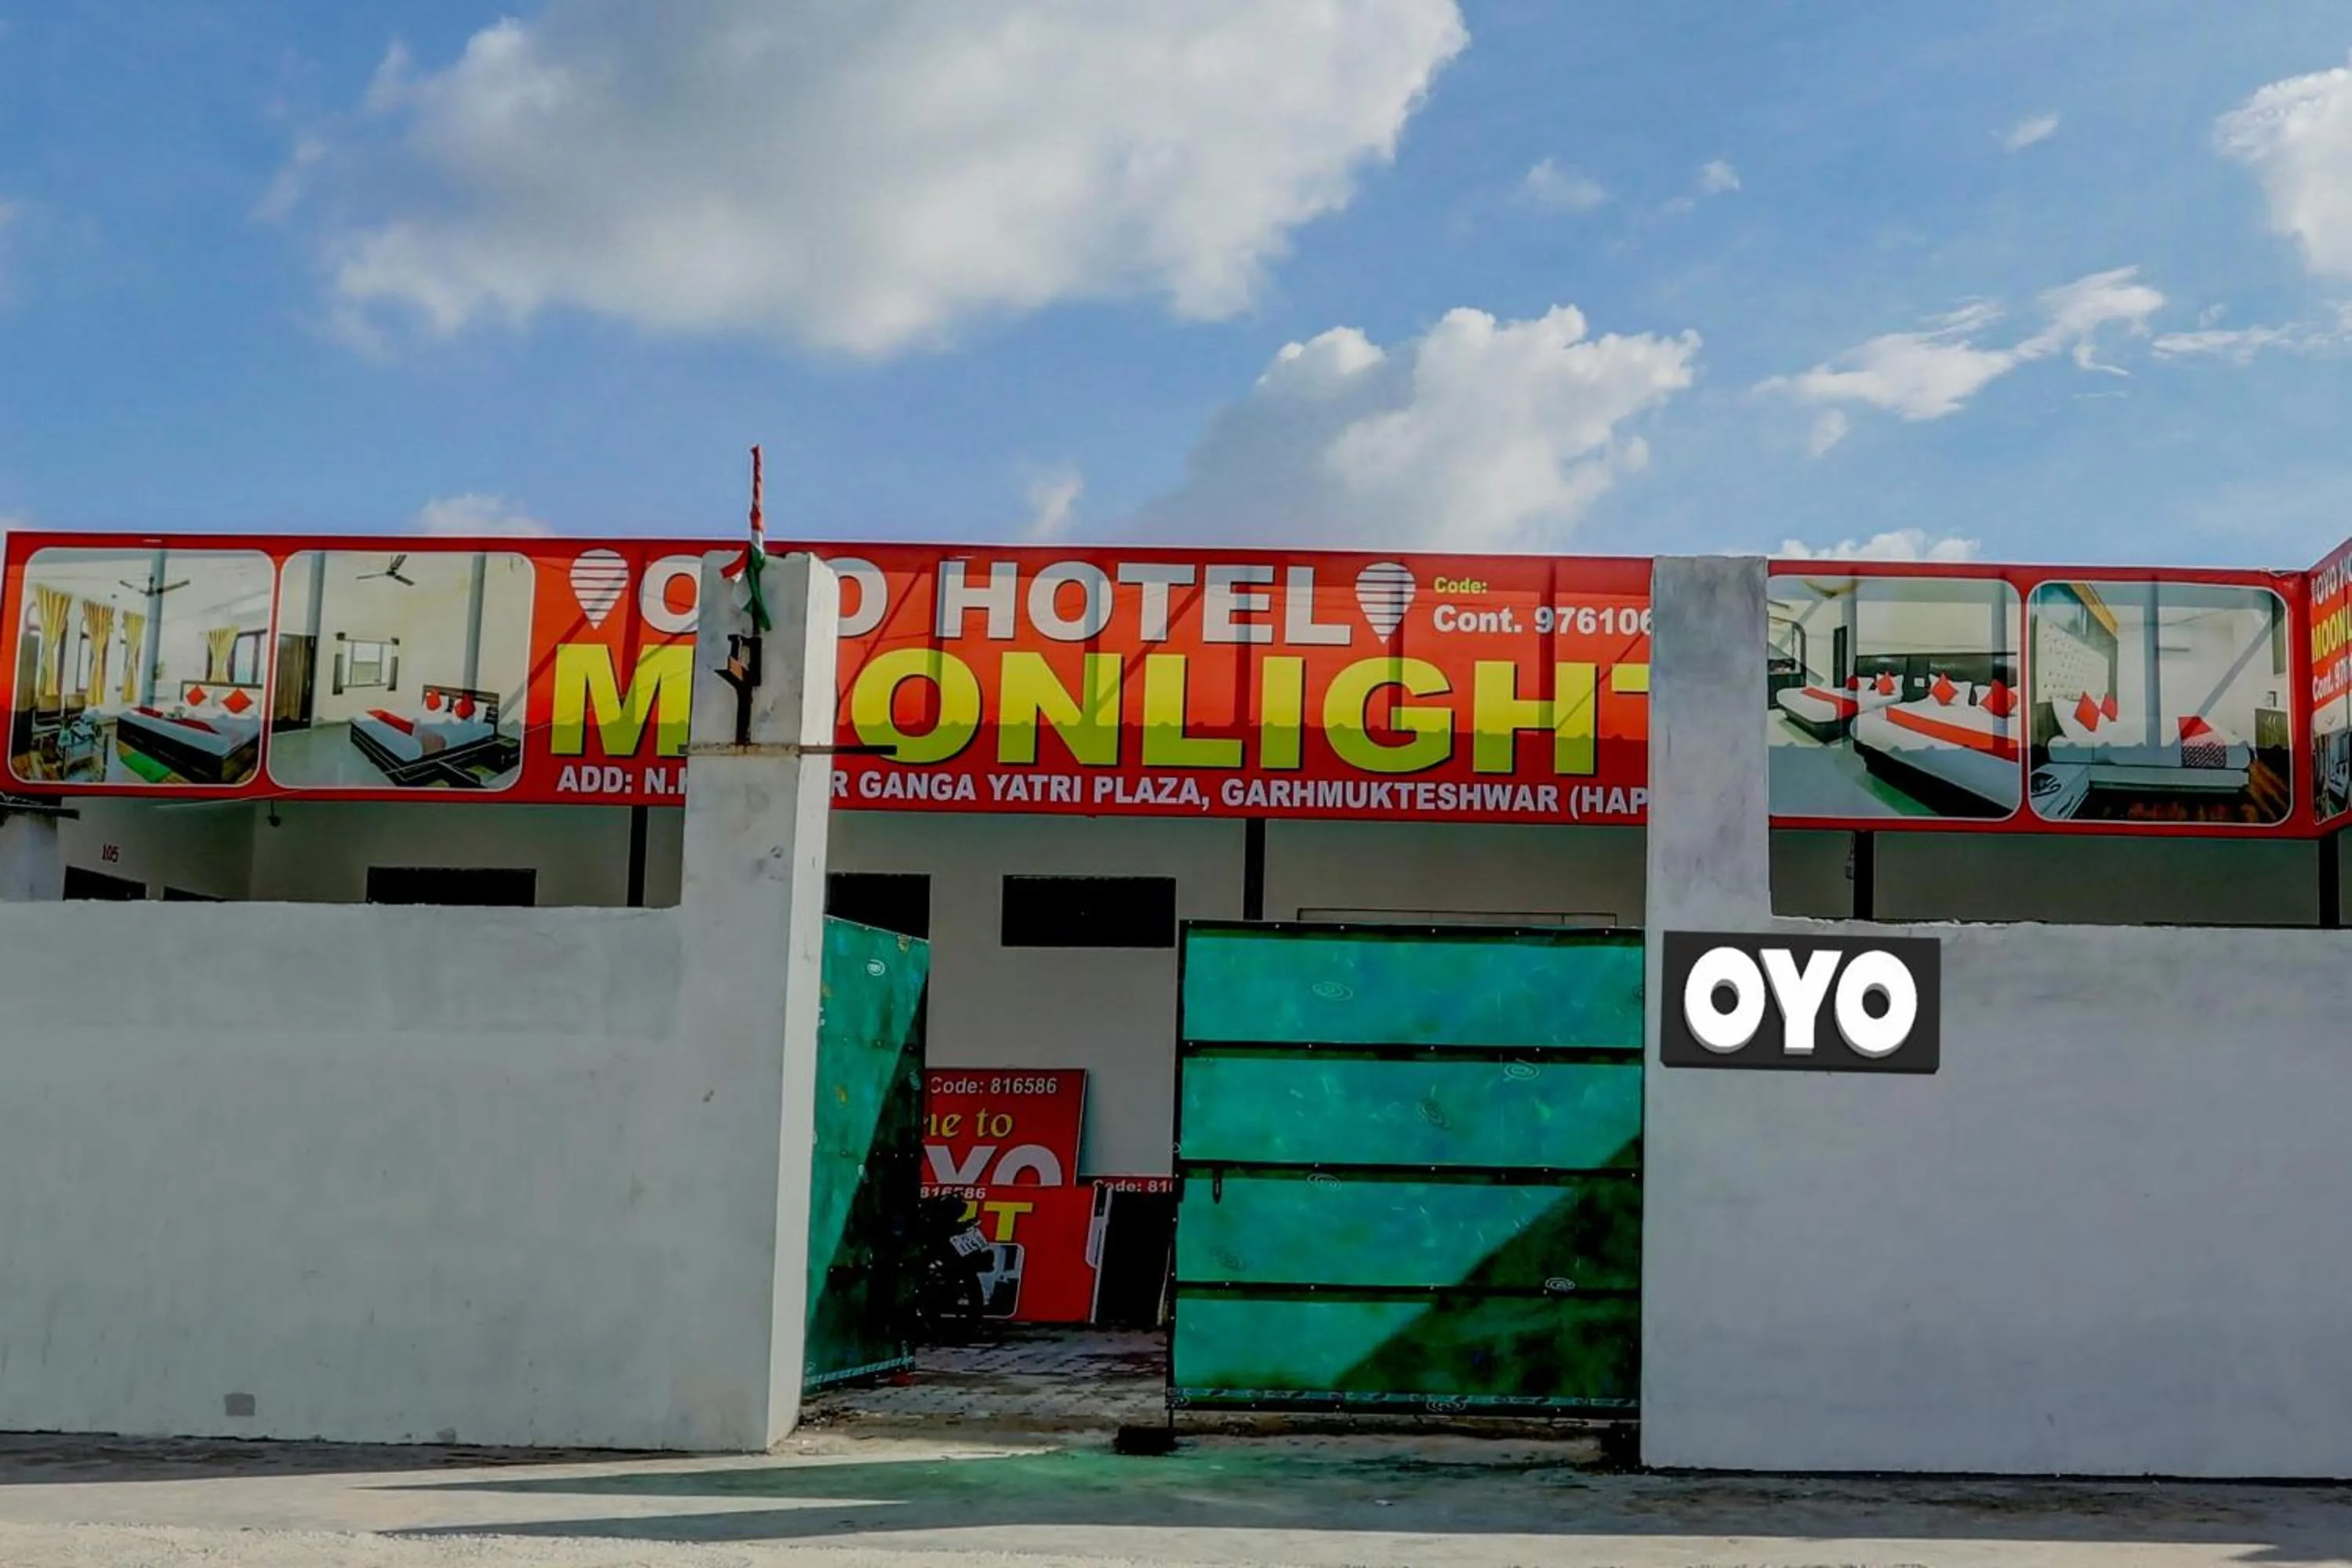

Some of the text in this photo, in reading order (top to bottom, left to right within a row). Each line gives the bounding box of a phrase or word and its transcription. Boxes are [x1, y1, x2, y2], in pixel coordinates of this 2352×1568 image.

[639, 554, 1352, 646] OO HOTEL
[1433, 576, 1488, 594] Code:
[1432, 604, 1523, 634] Cont.
[550, 641, 1650, 776] MONLIGH
[556, 764, 633, 794] ADD:
[858, 771, 977, 801] GANGA
[987, 774, 1081, 804] YATRI
[1093, 777, 1210, 811] PLAZA,
[1221, 779, 1559, 813] GARHMUKTESHWAR
[1684, 946, 1918, 1058] OYO
[990, 1077, 1058, 1094] 816586
[975, 1107, 1014, 1138] to
